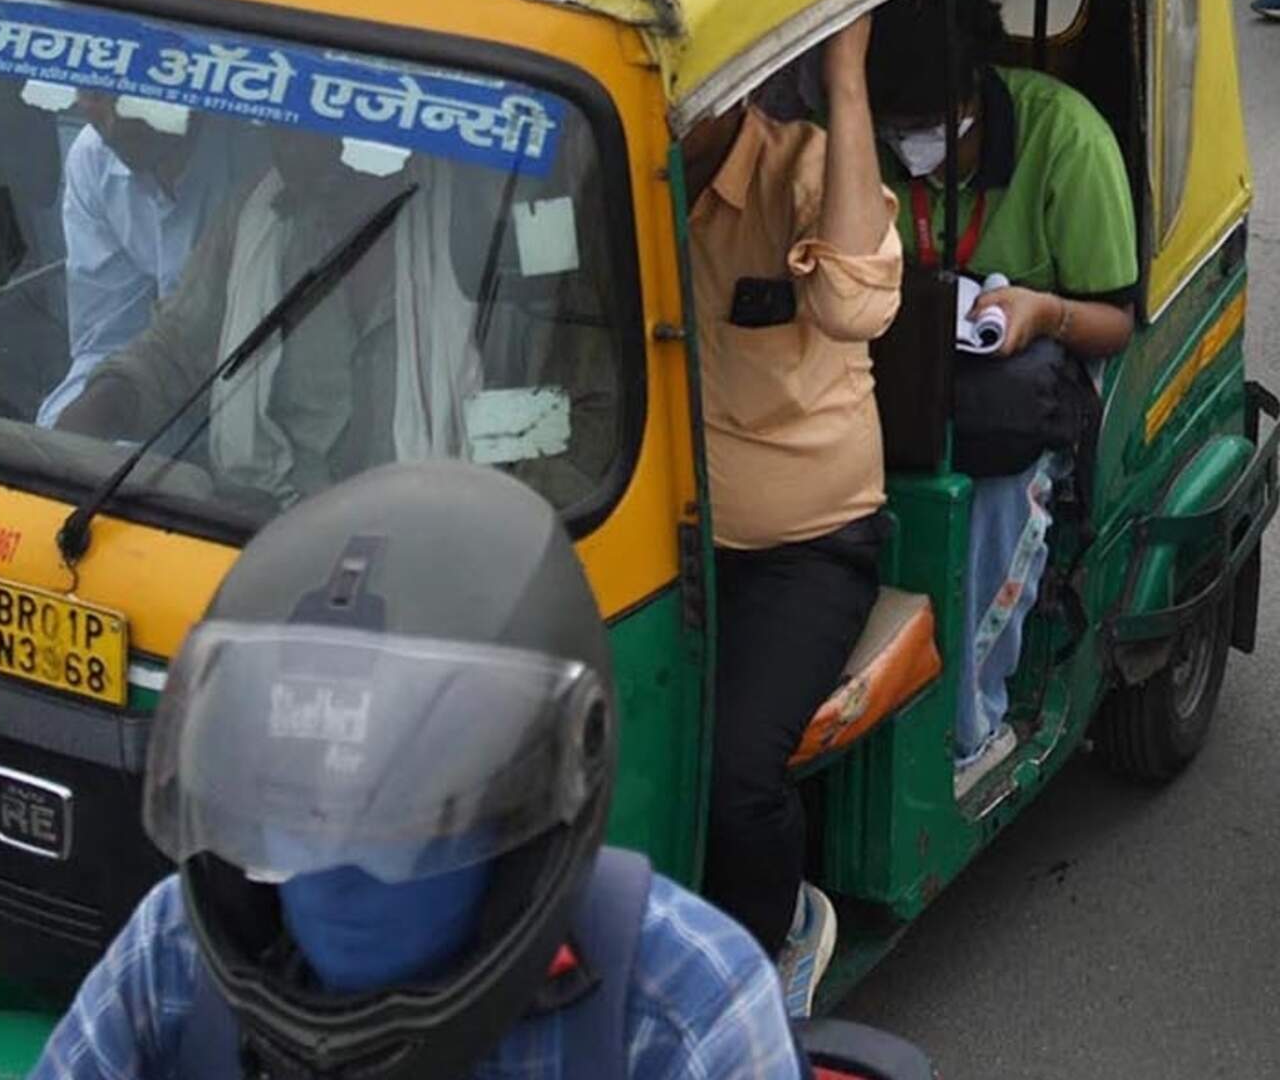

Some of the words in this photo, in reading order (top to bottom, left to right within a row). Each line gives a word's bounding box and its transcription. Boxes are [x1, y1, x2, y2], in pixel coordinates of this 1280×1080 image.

[146, 41, 297, 104] ऑटो
[310, 73, 557, 158] एजेन्सी
[0, 792, 58, 842] RE
